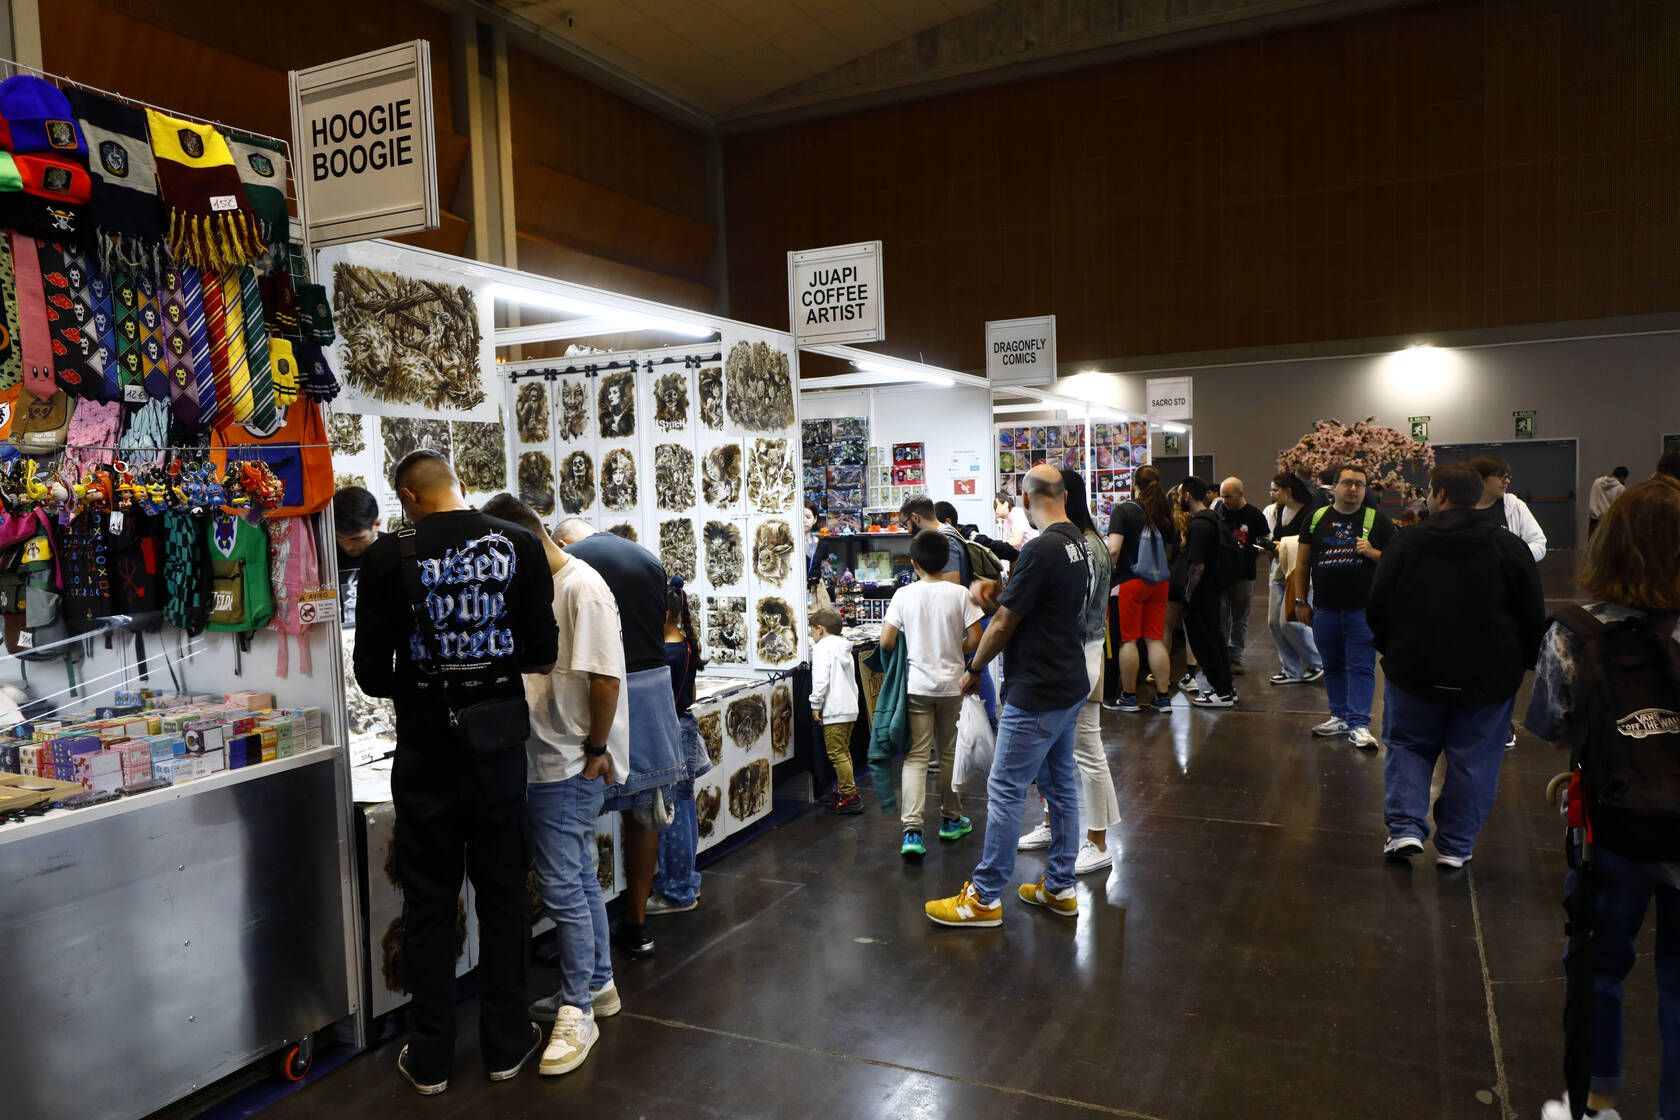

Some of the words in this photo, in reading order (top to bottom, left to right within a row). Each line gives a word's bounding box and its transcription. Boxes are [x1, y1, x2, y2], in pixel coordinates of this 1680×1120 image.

[312, 99, 412, 147] HOOGIE
[313, 135, 413, 182] BOOGIE
[809, 266, 857, 287] JUAPI
[802, 284, 868, 307] COFFEE
[806, 303, 865, 324] ARTIST
[993, 338, 1046, 353] DRAGONFLY
[1002, 352, 1036, 365] COMICS
[1151, 399, 1173, 407] SACRO
[1174, 397, 1186, 405] STD
[416, 547, 510, 587] aised
[457, 583, 508, 627] the
